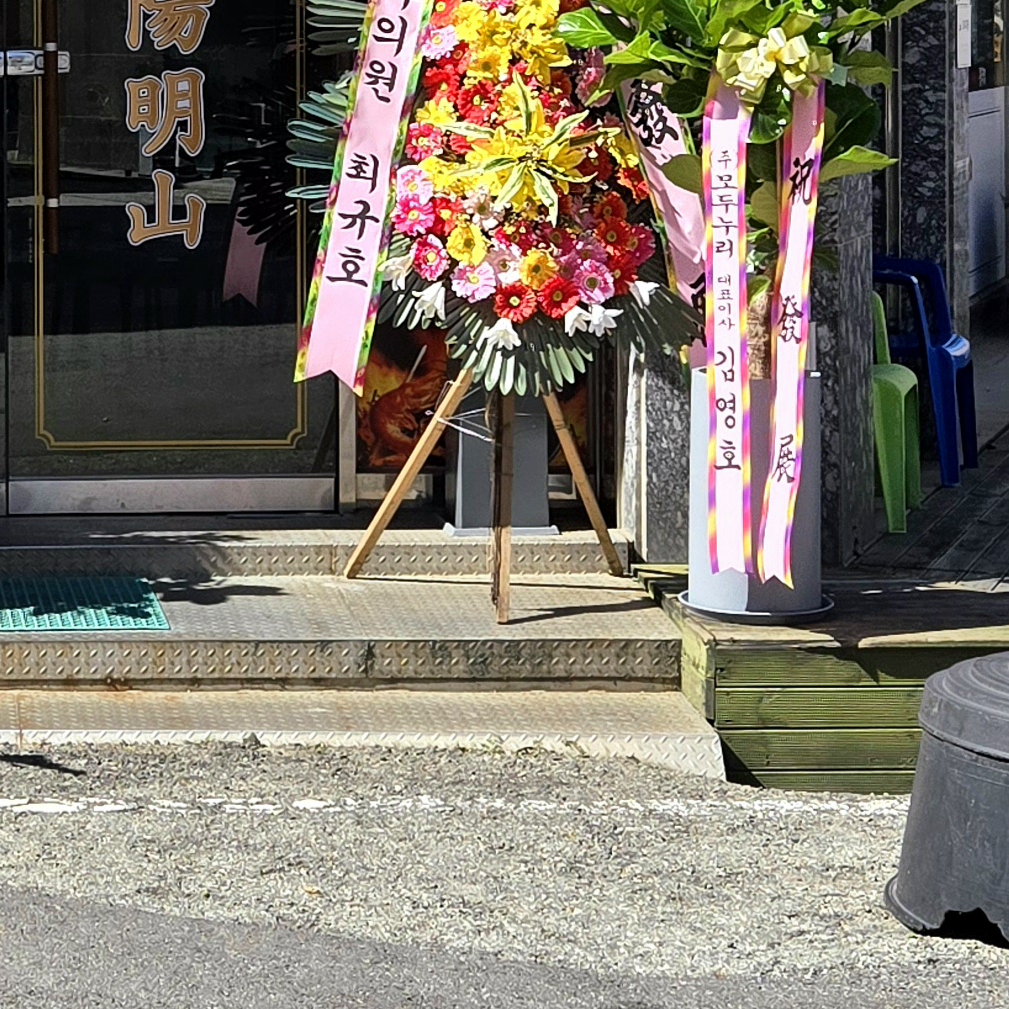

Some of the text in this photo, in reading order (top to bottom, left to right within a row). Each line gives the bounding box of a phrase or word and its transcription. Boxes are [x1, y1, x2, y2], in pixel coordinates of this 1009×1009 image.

[326, 154, 380, 288] 최규호
[716, 273, 736, 330] 대표이사
[713, 345, 742, 470] 김영호
